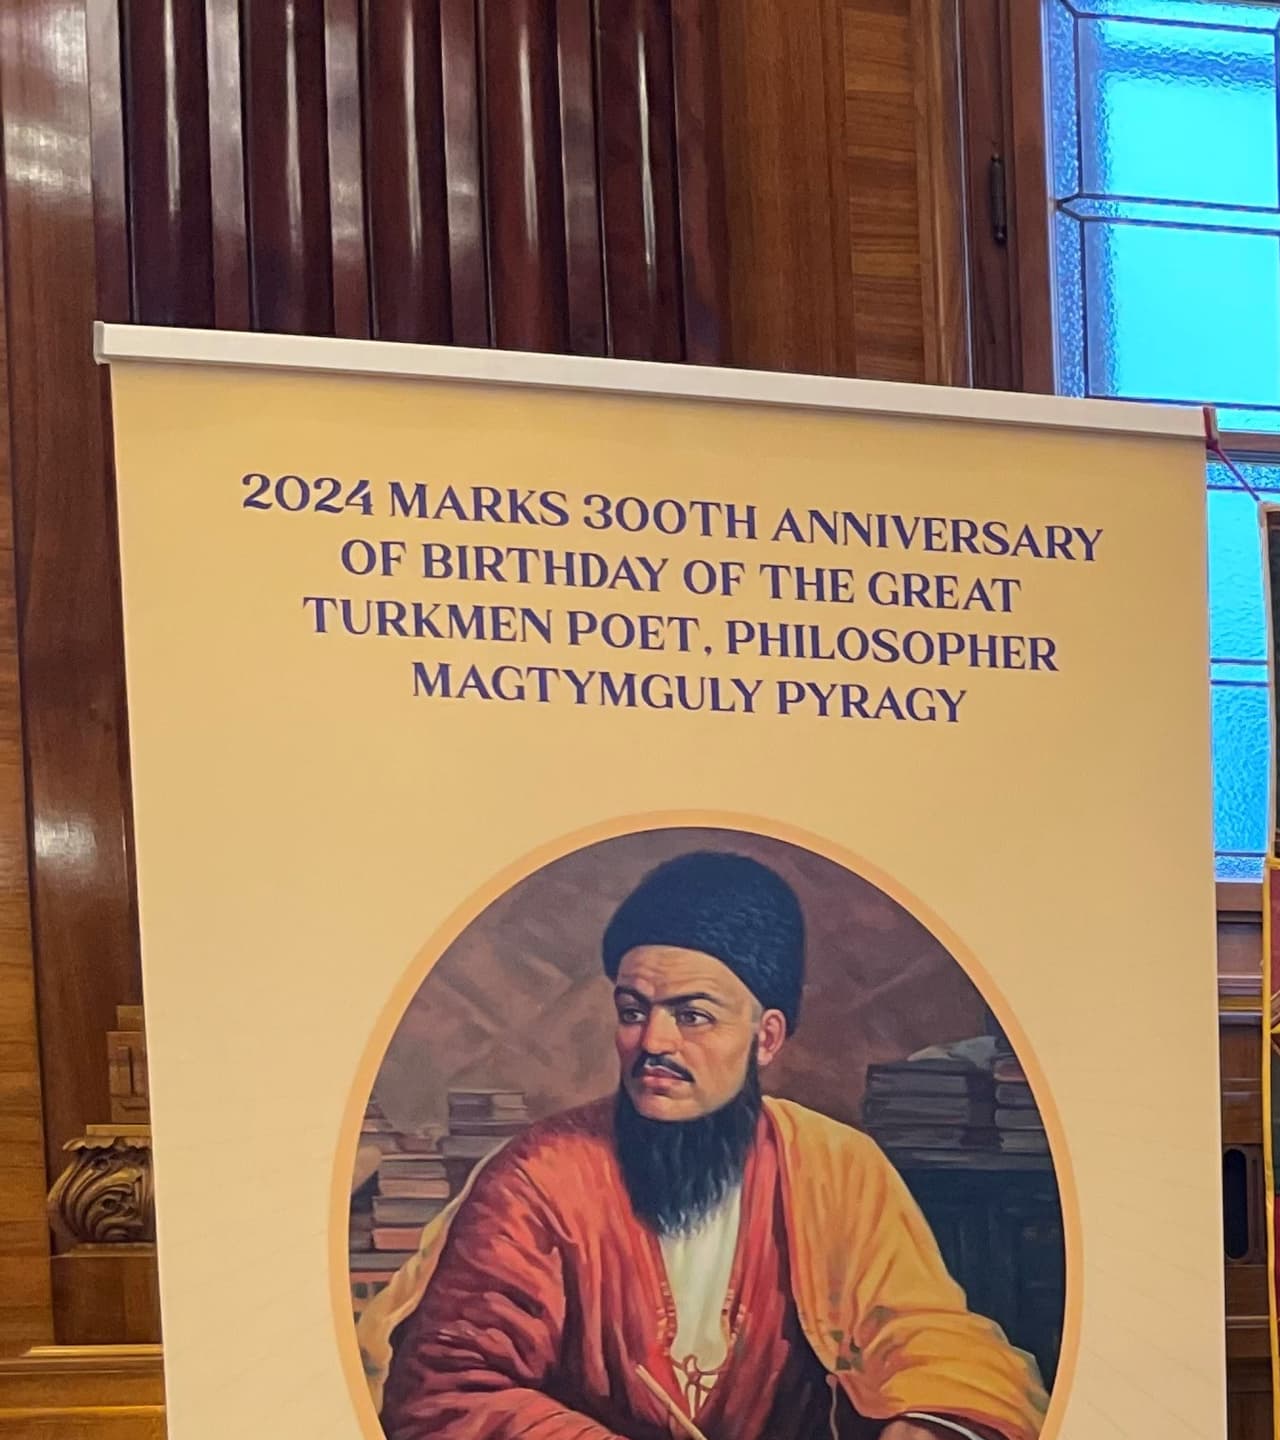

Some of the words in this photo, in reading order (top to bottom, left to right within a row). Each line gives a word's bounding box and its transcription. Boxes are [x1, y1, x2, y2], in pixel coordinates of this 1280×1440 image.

[243, 474, 373, 515] 2024
[389, 482, 569, 526] MARKS
[584, 494, 757, 539] 300TH
[771, 508, 1103, 561] ANNIVERSARY
[342, 540, 406, 576] OF
[422, 544, 668, 592] BIRTHDAY
[684, 560, 745, 596] OF
[760, 564, 854, 603] THE
[869, 572, 1021, 612] GREAT
[303, 597, 552, 643] TURKMEN
[567, 611, 711, 655] POET,
[726, 620, 1059, 671] PHILOSOPHER
[412, 662, 763, 713] MAGTYMGULY
[776, 681, 966, 722] PYRAGY
